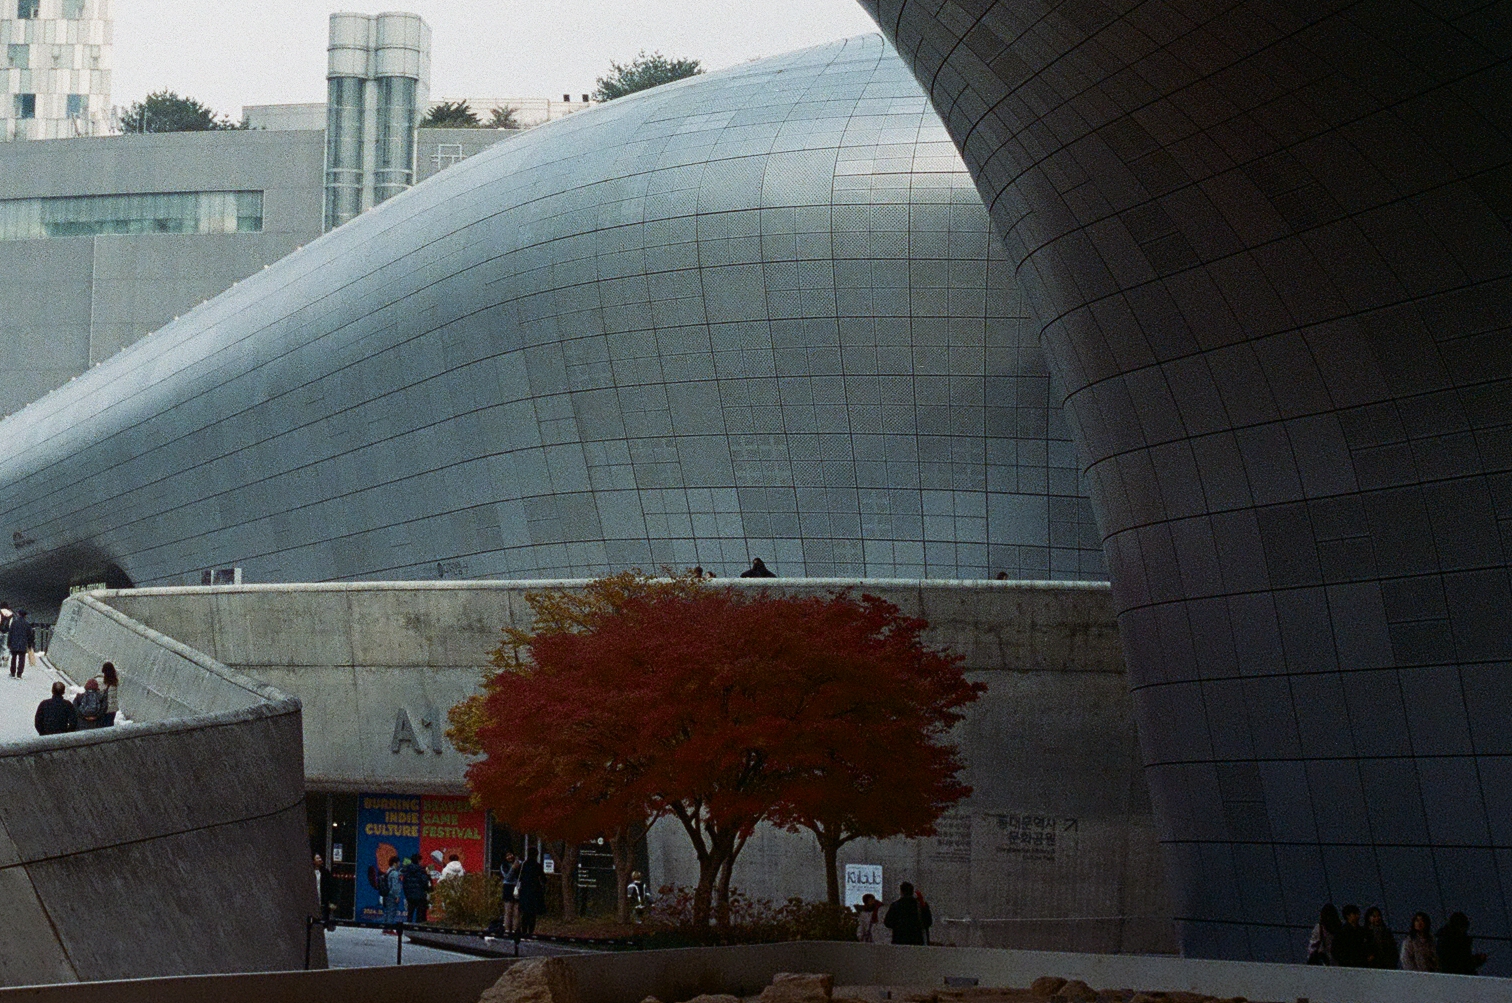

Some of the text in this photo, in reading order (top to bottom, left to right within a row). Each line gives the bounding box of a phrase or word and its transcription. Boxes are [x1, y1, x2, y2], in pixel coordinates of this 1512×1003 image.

[391, 706, 443, 755] A1
[363, 797, 420, 811] BURNING
[384, 811, 459, 825] INDIE GAME
[997, 814, 1057, 831] 동대문역사
[364, 823, 482, 840] CULTURE FESTIVAL
[1008, 830, 1057, 846] 문화공원
